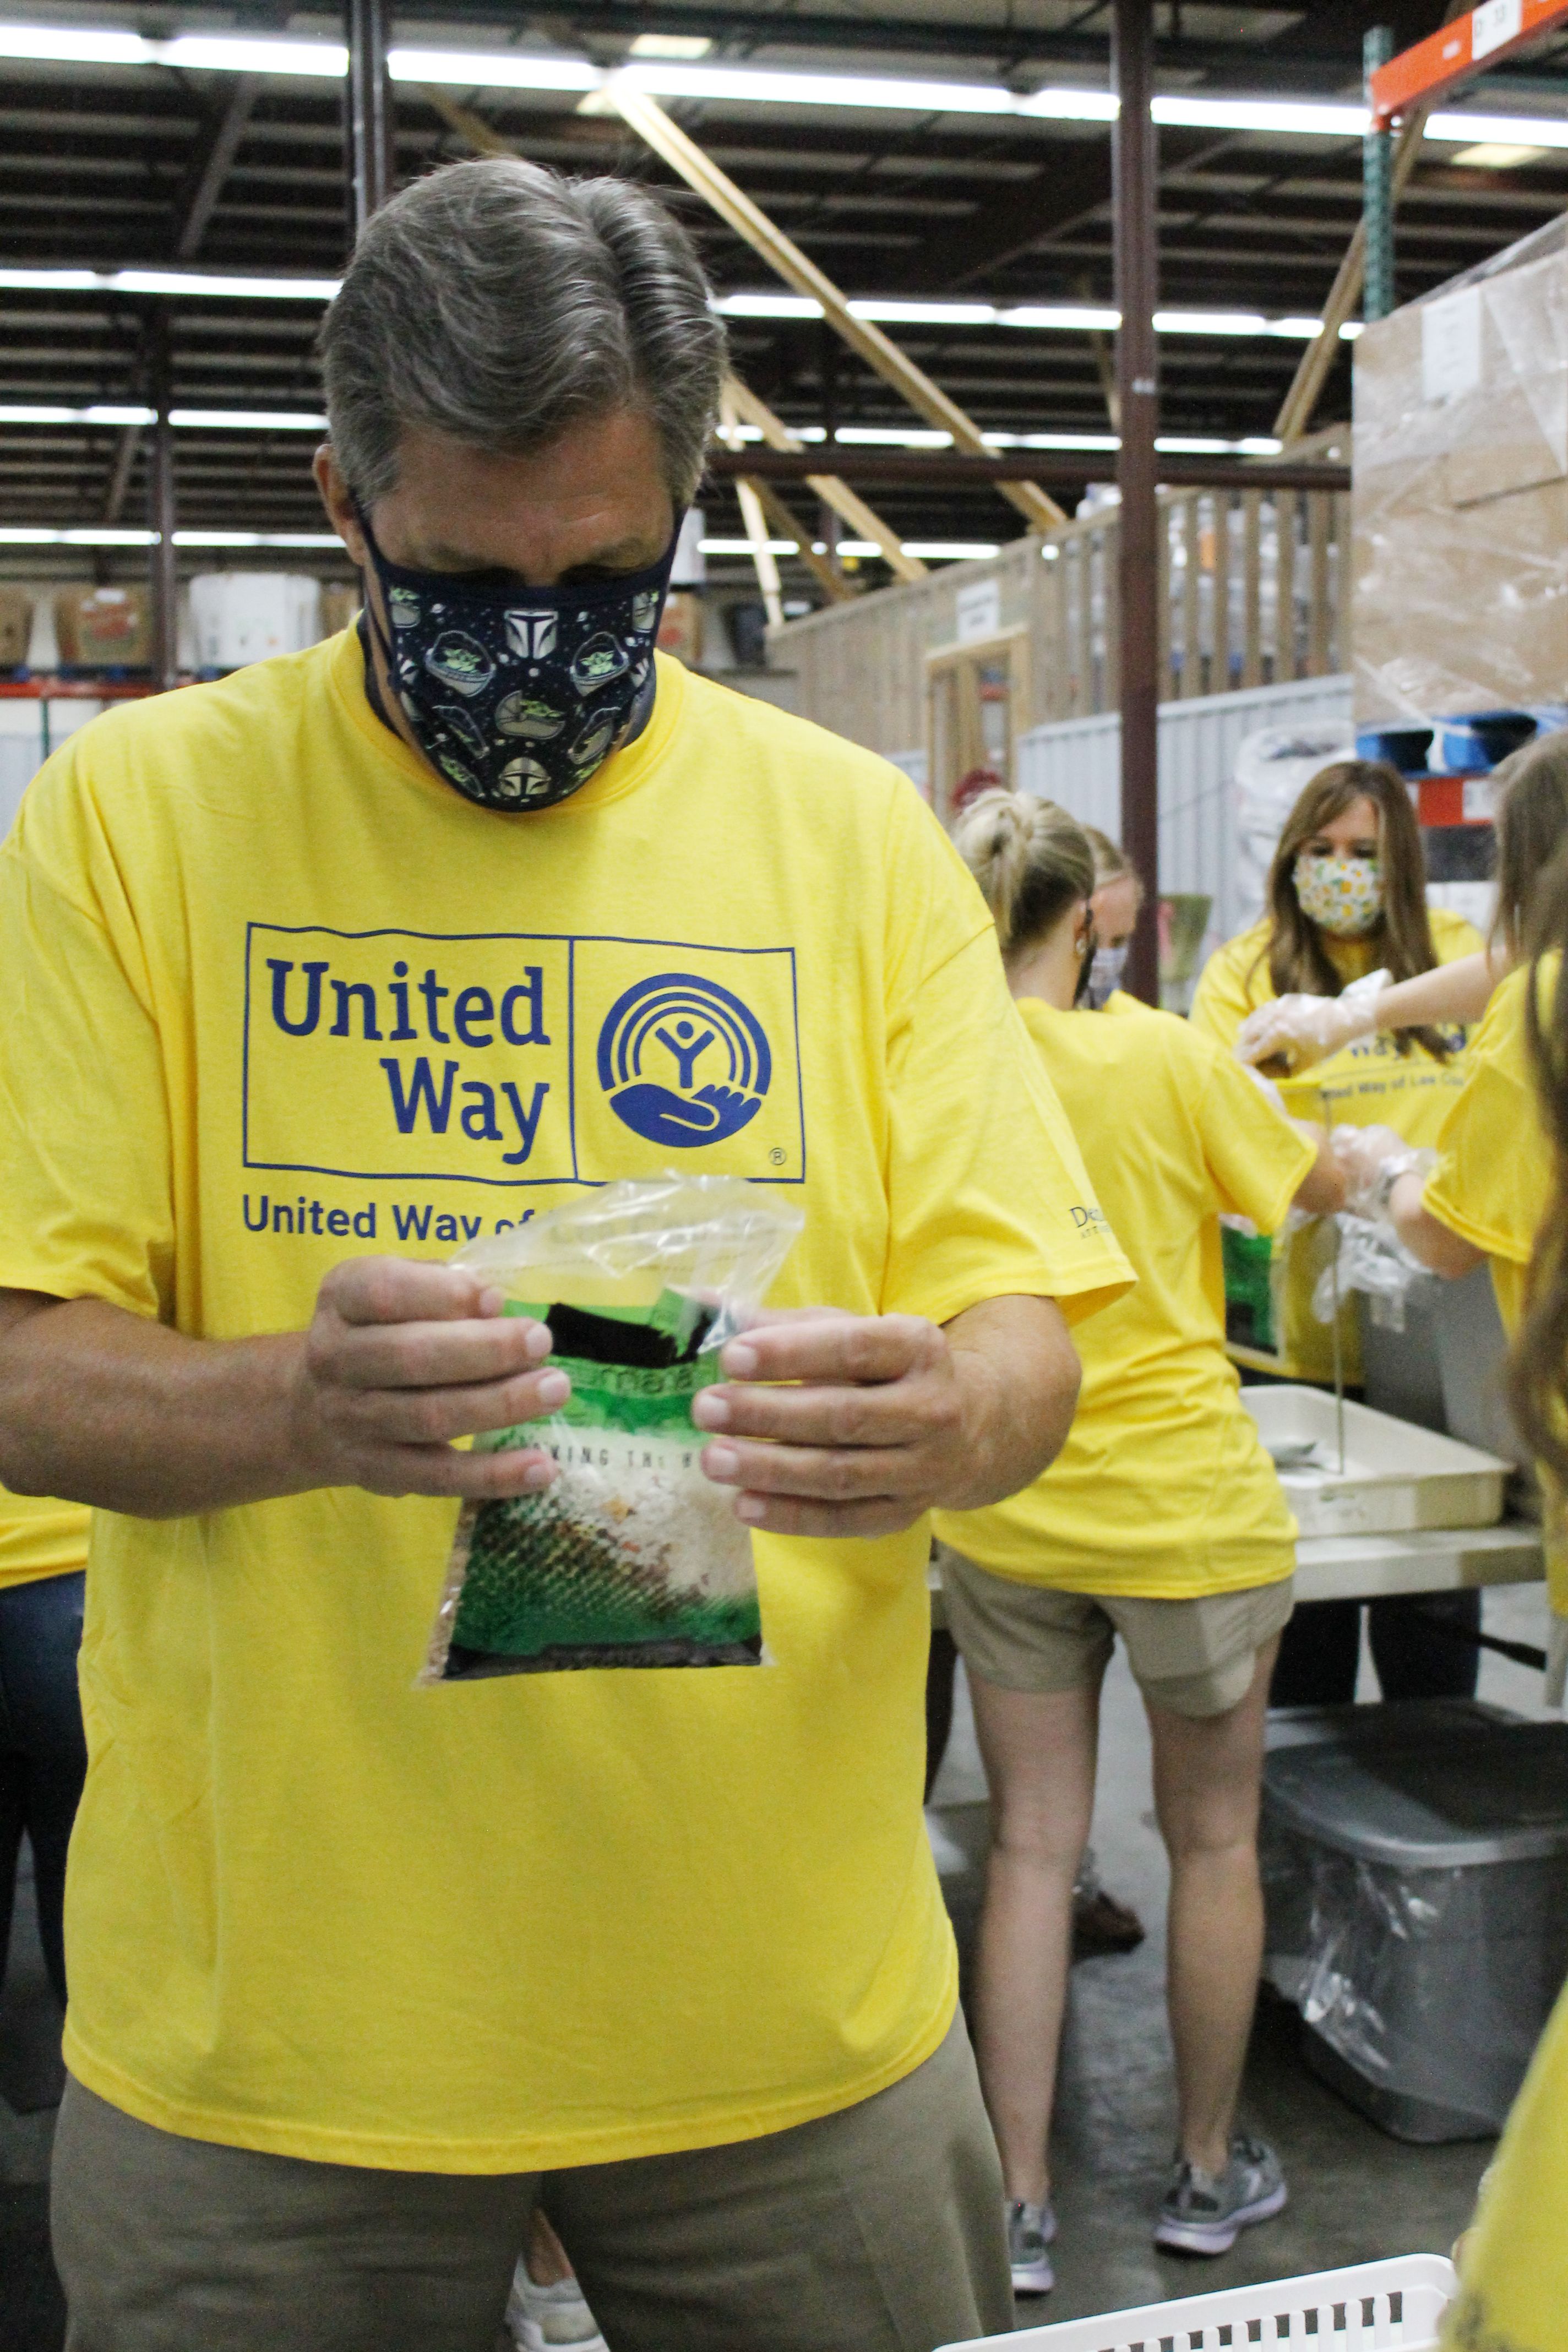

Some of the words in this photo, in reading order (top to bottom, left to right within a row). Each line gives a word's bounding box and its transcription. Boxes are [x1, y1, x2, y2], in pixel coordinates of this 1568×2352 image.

[266, 959, 551, 1048] United
[379, 1057, 550, 1164] Way
[243, 1194, 377, 1239] United
[391, 1205, 482, 1241] Way
